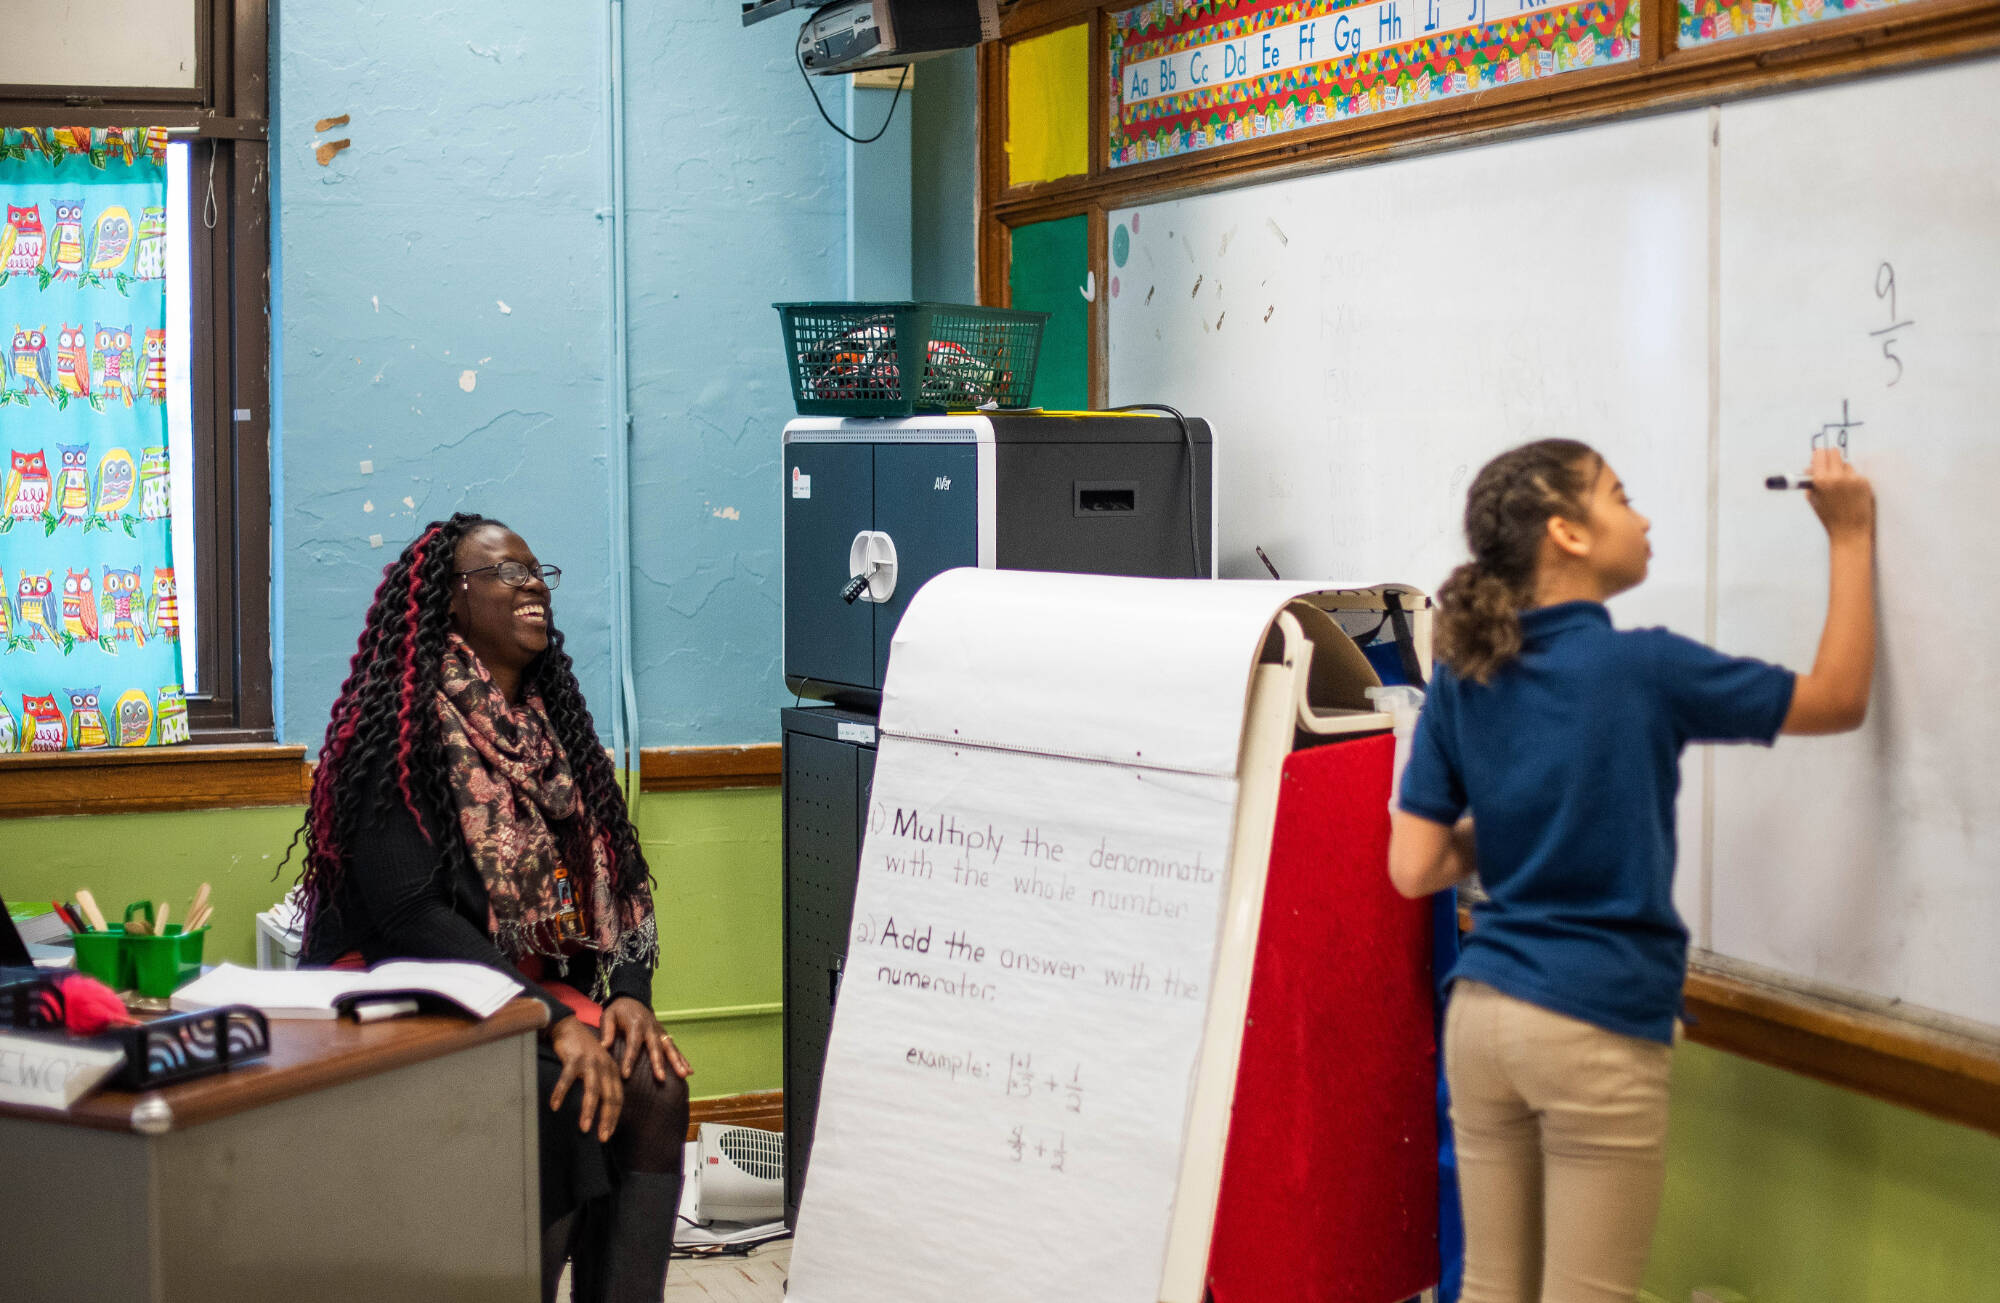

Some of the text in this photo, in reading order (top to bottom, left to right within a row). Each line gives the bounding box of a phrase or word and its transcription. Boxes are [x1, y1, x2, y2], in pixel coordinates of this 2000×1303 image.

[1131, 70, 1149, 98] Aa
[1160, 59, 1177, 92] Bb
[1190, 51, 1208, 85] Cc
[1224, 40, 1247, 79] Dd
[1262, 33, 1280, 69] Ee
[1299, 23, 1316, 61] Ff
[1334, 15, 1361, 58] Gg
[1379, 1, 1401, 43] Hh
[1424, 0, 1439, 31] Ii
[1875, 261, 1895, 322] 9
[1883, 338, 1902, 387] 5
[892, 808, 1004, 864] Multiply
[1021, 827, 1064, 862] the
[885, 850, 1188, 919] with the whole number
[880, 917, 932, 953] Add
[945, 931, 985, 963] the
[1000, 949, 1085, 980] answer
[1104, 962, 1150, 992] with
[1164, 975, 1199, 1001] the
[906, 1047, 990, 1080] example:
